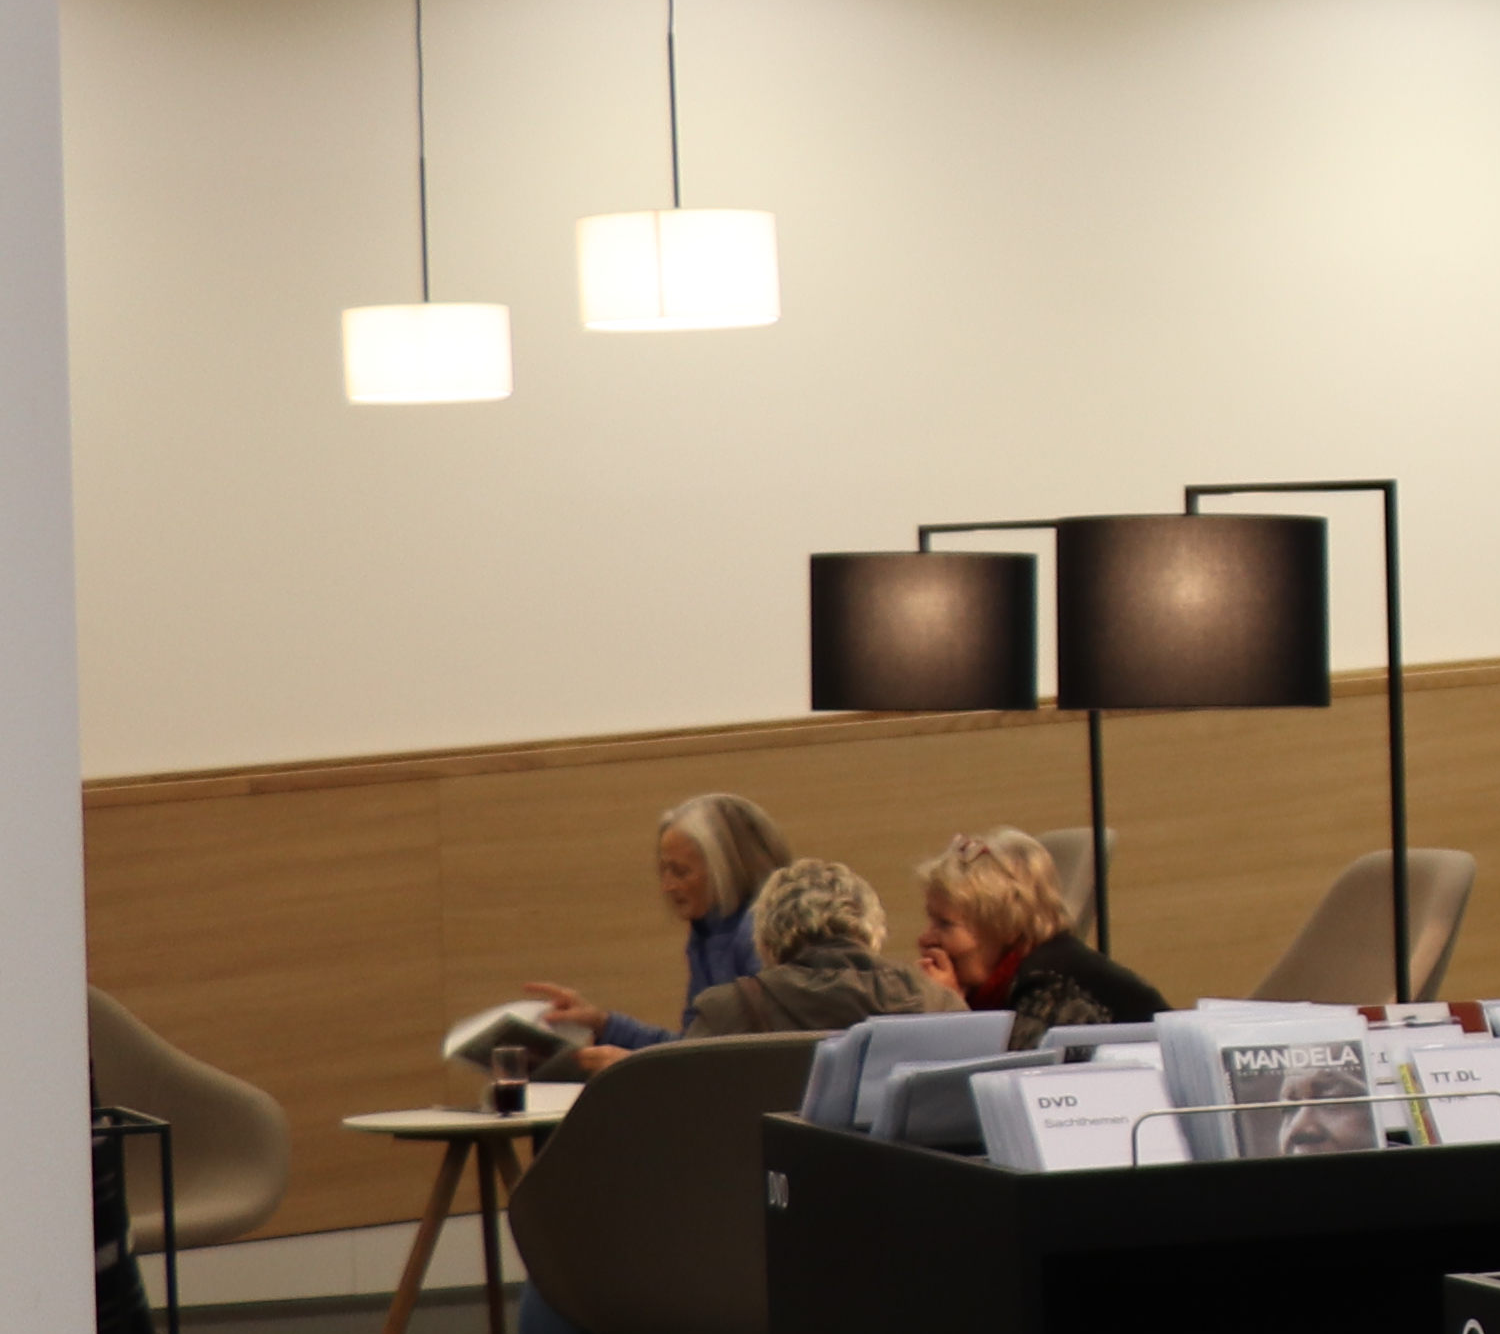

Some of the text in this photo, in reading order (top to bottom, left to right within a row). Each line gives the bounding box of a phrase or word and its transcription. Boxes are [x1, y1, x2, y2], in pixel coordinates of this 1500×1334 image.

[1233, 1045, 1360, 1071] MANDELA
[1430, 1069, 1482, 1084] TT.DL
[1037, 1094, 1079, 1110] DVD
[1044, 1115, 1130, 1129] Sachthemen
